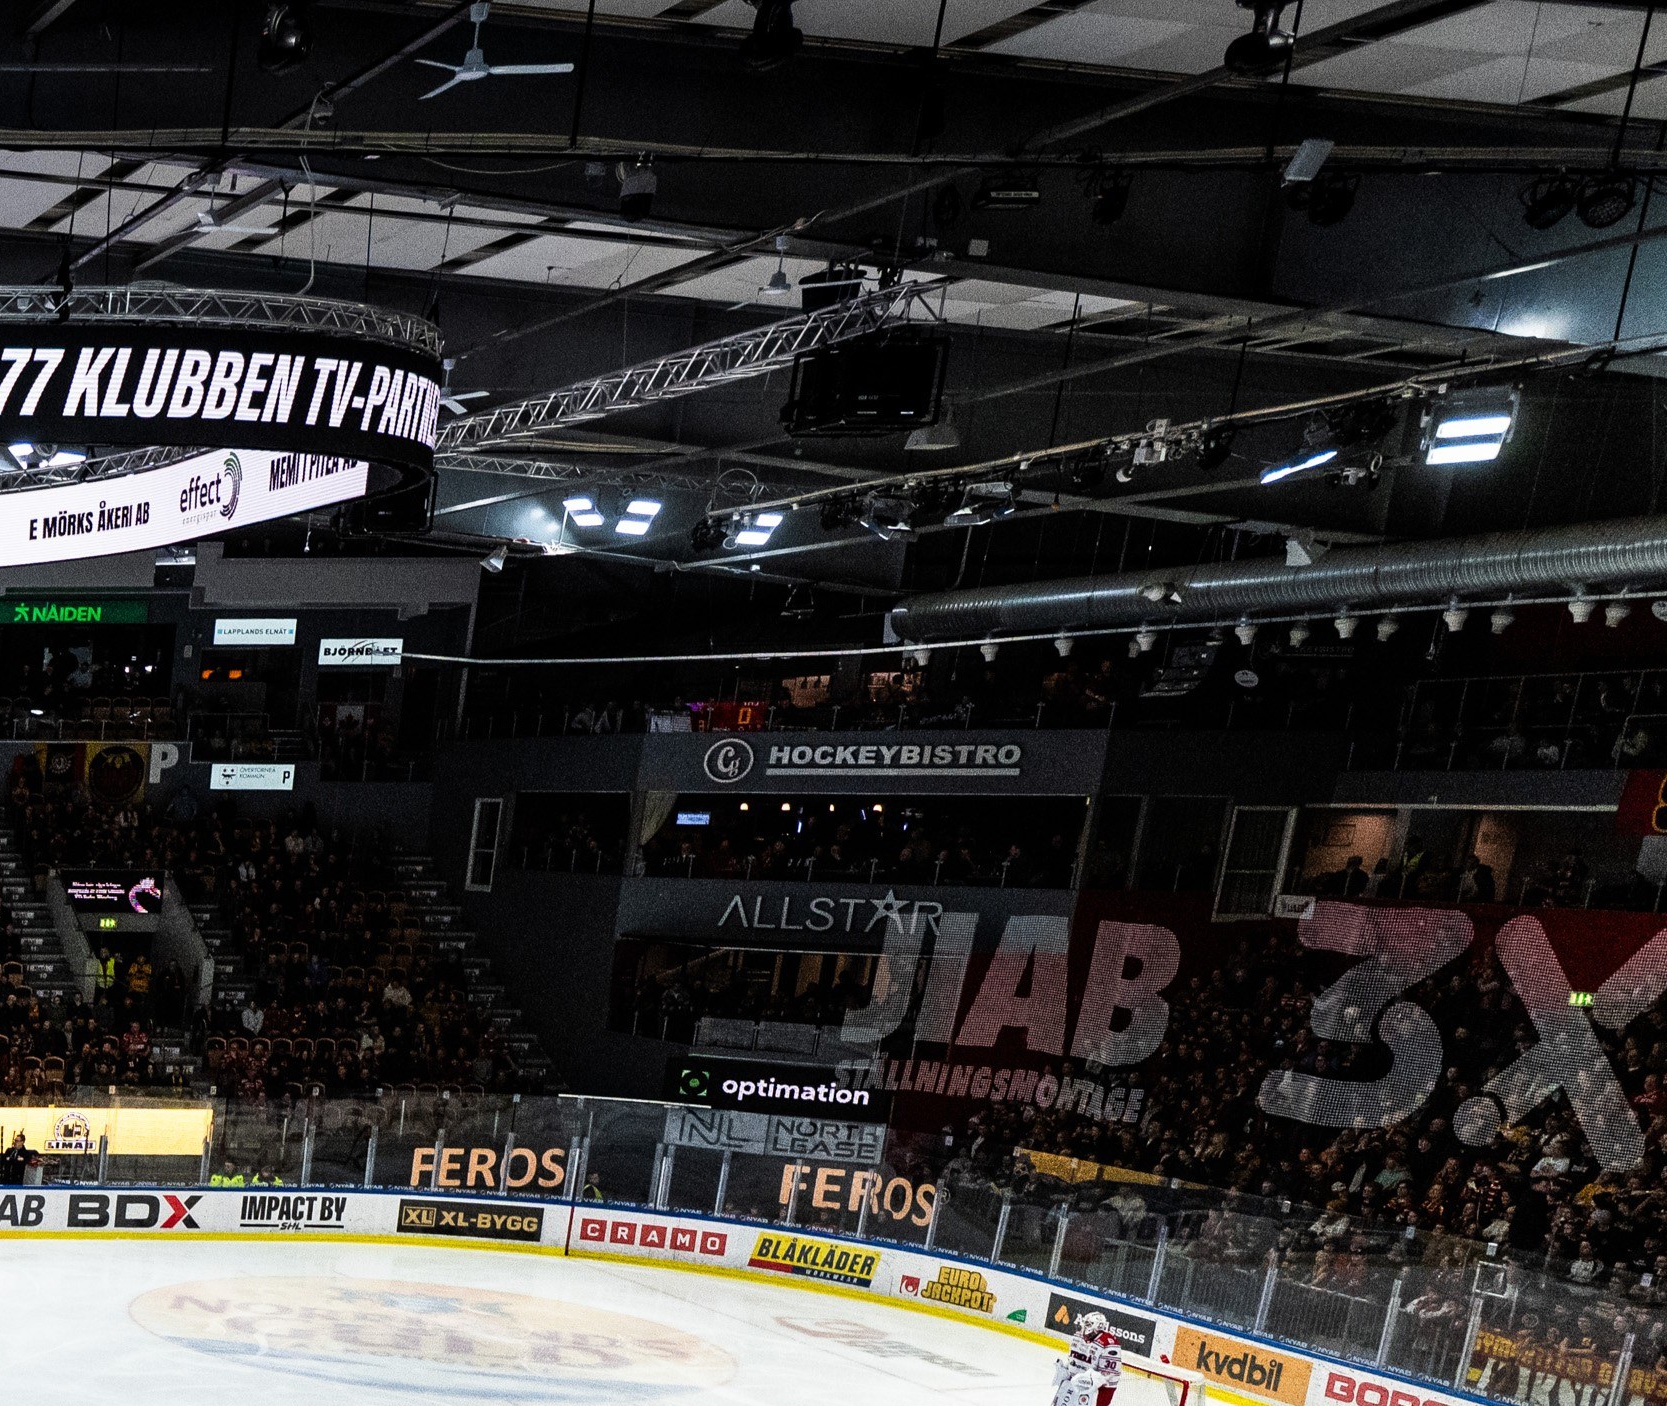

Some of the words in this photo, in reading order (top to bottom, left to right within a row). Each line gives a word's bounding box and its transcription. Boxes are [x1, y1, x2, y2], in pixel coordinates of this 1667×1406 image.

[63, 348, 306, 424] KLUBBEN
[179, 473, 222, 513] effect
[29, 516, 39, 541] E
[42, 506, 94, 540] MÖRKS
[98, 500, 134, 534] ÅKERI
[134, 501, 151, 528] AB
[769, 744, 1021, 765] HOCKEYBISTRO
[282, 770, 290, 784] P
[840, 912, 1182, 1066] JIAB
[721, 1075, 870, 1107] optimation
[47, 1141, 94, 1150] LIMAB
[410, 1147, 565, 1188] FEROS
[241, 1196, 318, 1221] IMPACT
[321, 1196, 347, 1222] BY
[778, 1163, 938, 1227] FEROS
[67, 1195, 203, 1229] BDX
[280, 1222, 302, 1231] SHL
[440, 1211, 539, 1232] XL-BYGG
[586, 1222, 720, 1251] CRAMO
[757, 1235, 876, 1278] BLÅKLÄDER
[938, 1266, 988, 1292] EURO
[921, 1281, 997, 1315] JACKPOT
[1104, 1359, 1117, 1370] 30
[1196, 1341, 1284, 1392] kvdbil
